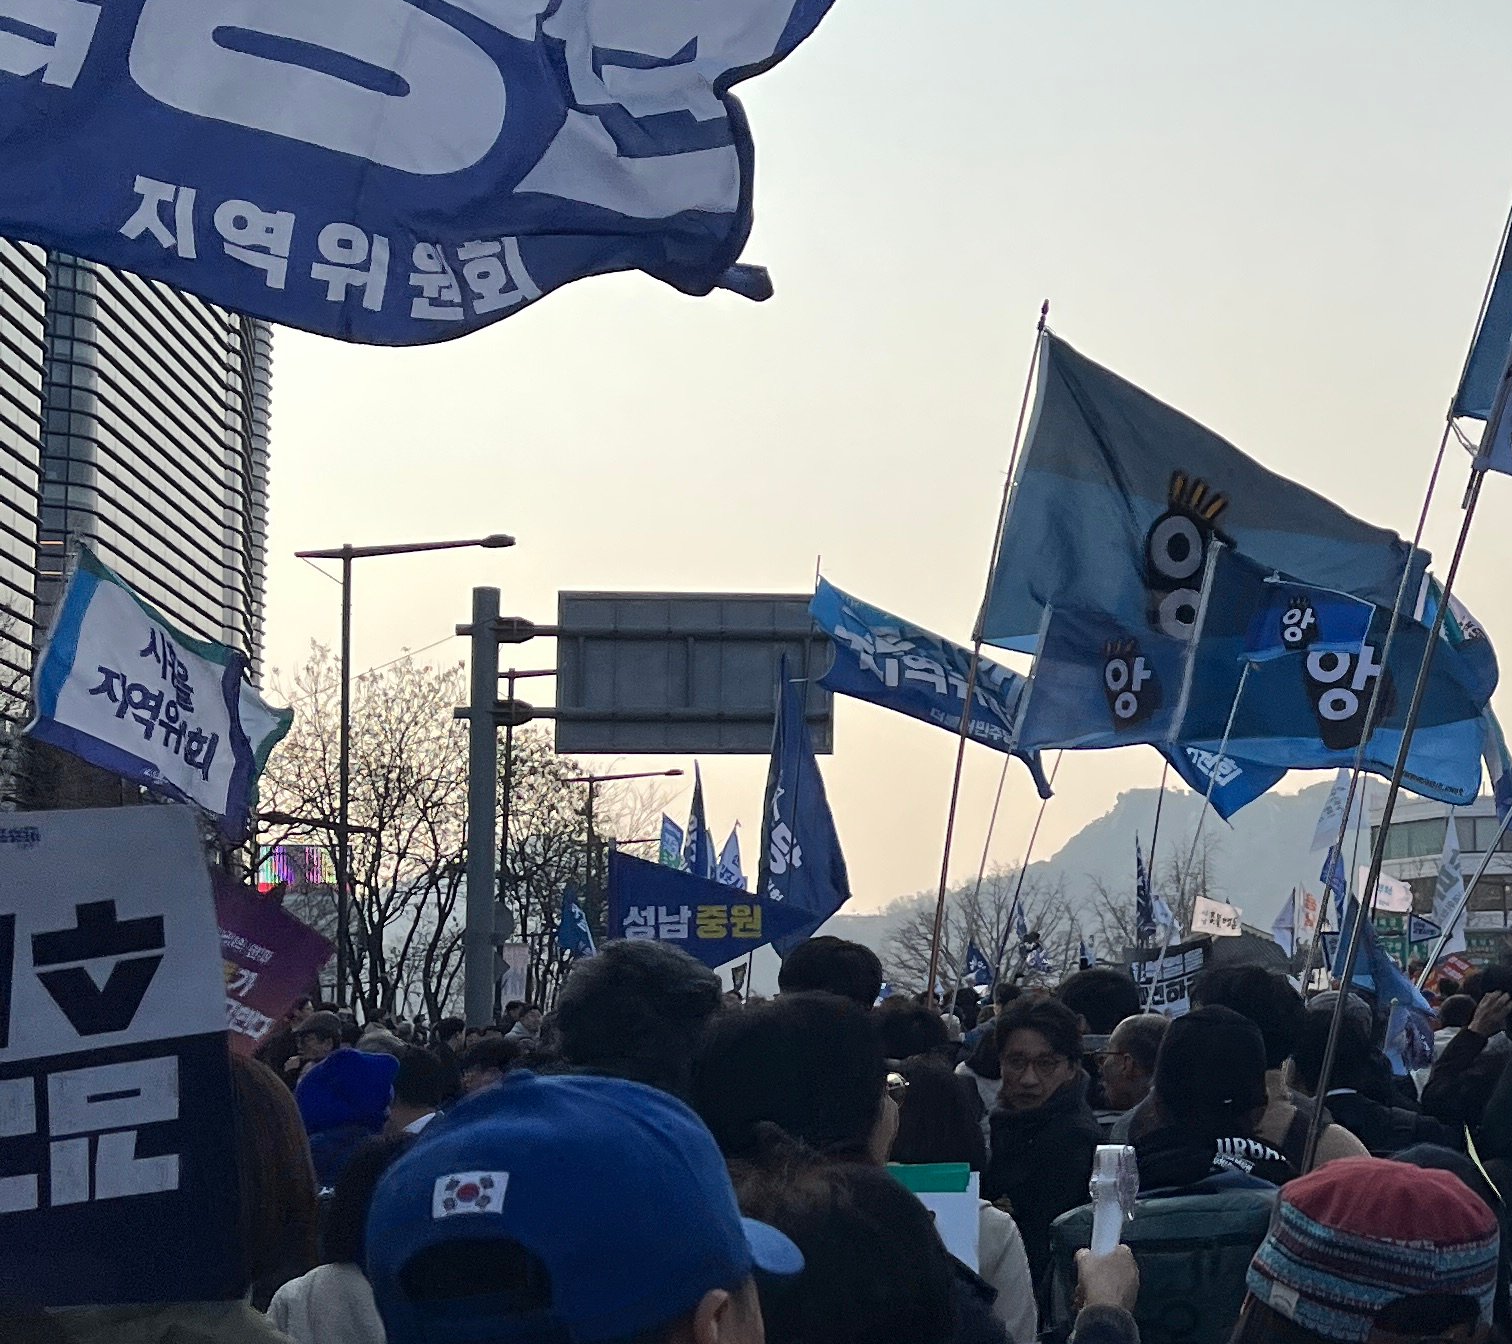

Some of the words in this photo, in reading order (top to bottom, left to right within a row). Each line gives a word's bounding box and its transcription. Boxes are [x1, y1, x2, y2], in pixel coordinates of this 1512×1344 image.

[118, 174, 543, 321] 지역위원회
[1104, 656, 1152, 720] 앙
[622, 904, 692, 940] 성남
[695, 904, 763, 940] 중원
